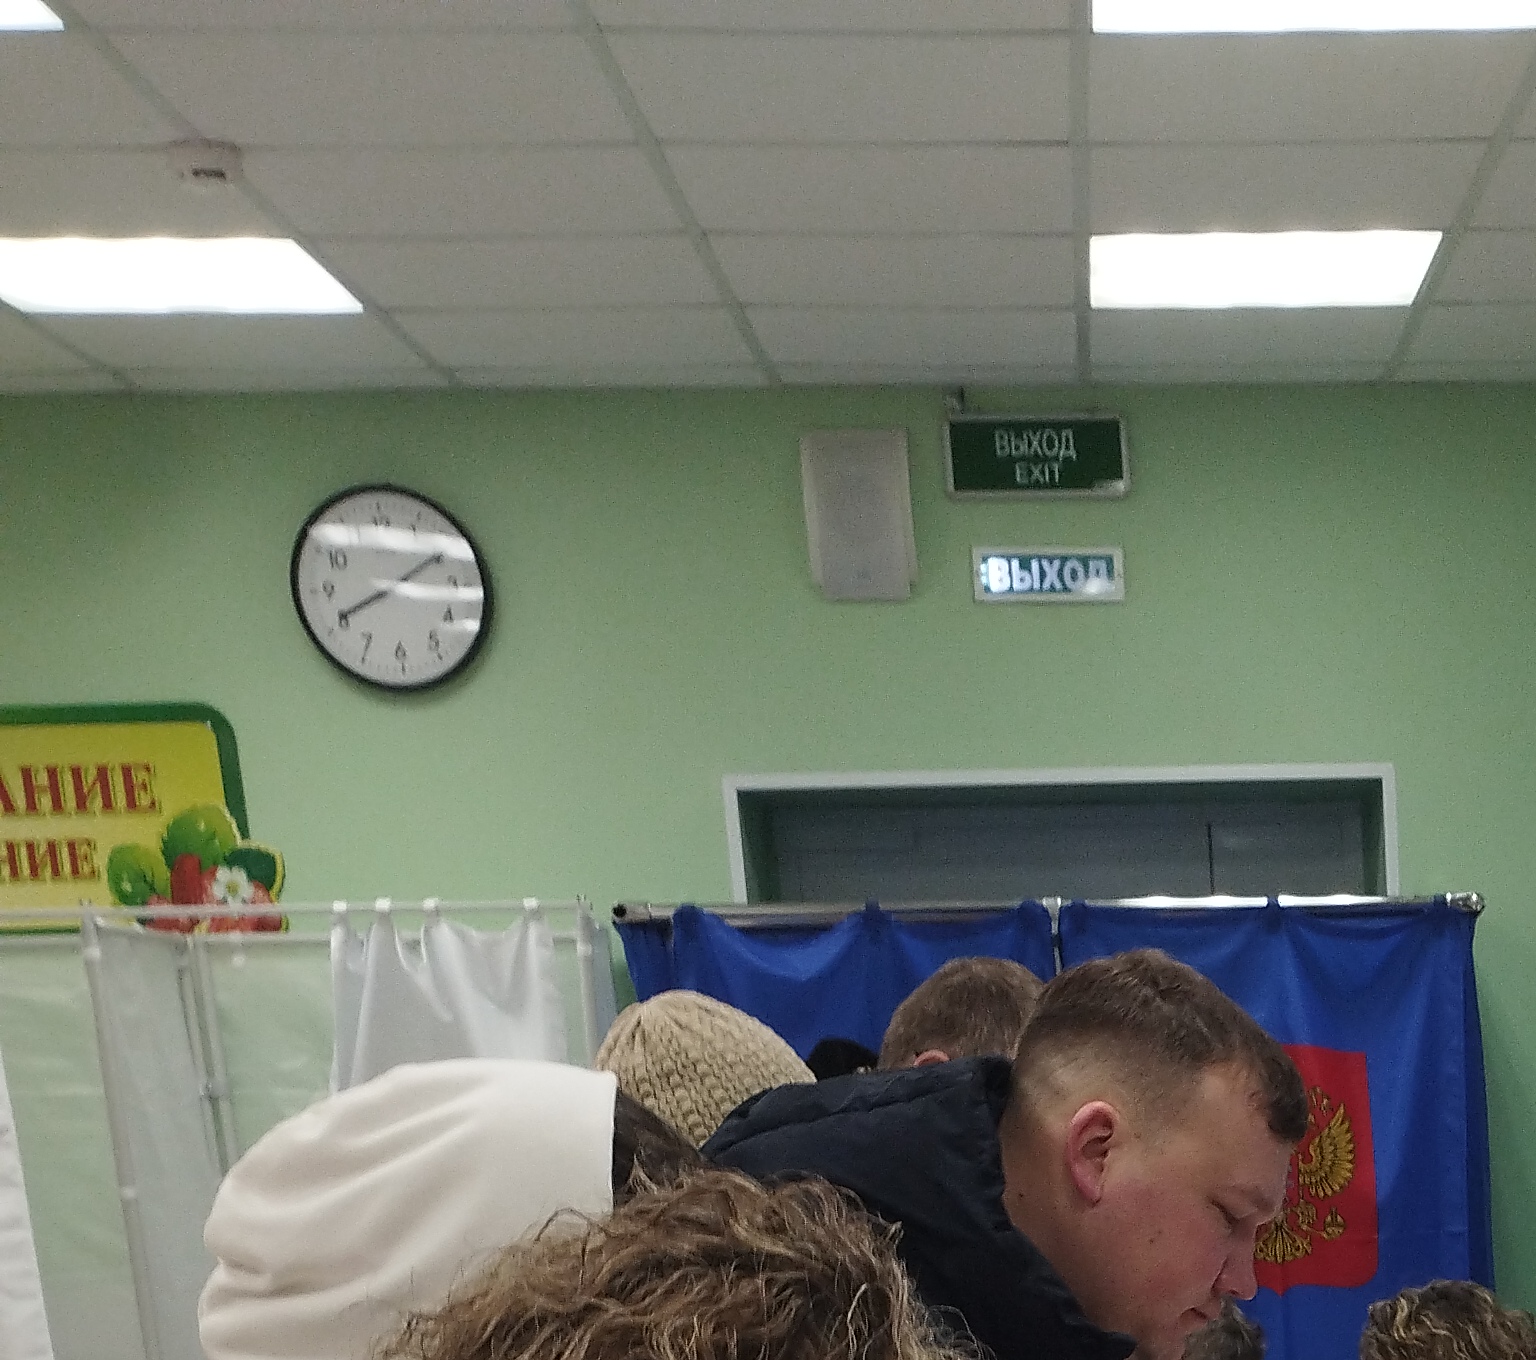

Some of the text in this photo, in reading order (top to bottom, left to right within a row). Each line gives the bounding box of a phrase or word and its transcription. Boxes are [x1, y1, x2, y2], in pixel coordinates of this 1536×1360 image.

[995, 428, 1077, 461] ВЫХОД
[1015, 461, 1060, 484] EXIT
[987, 556, 1115, 594] ВЫХОД
